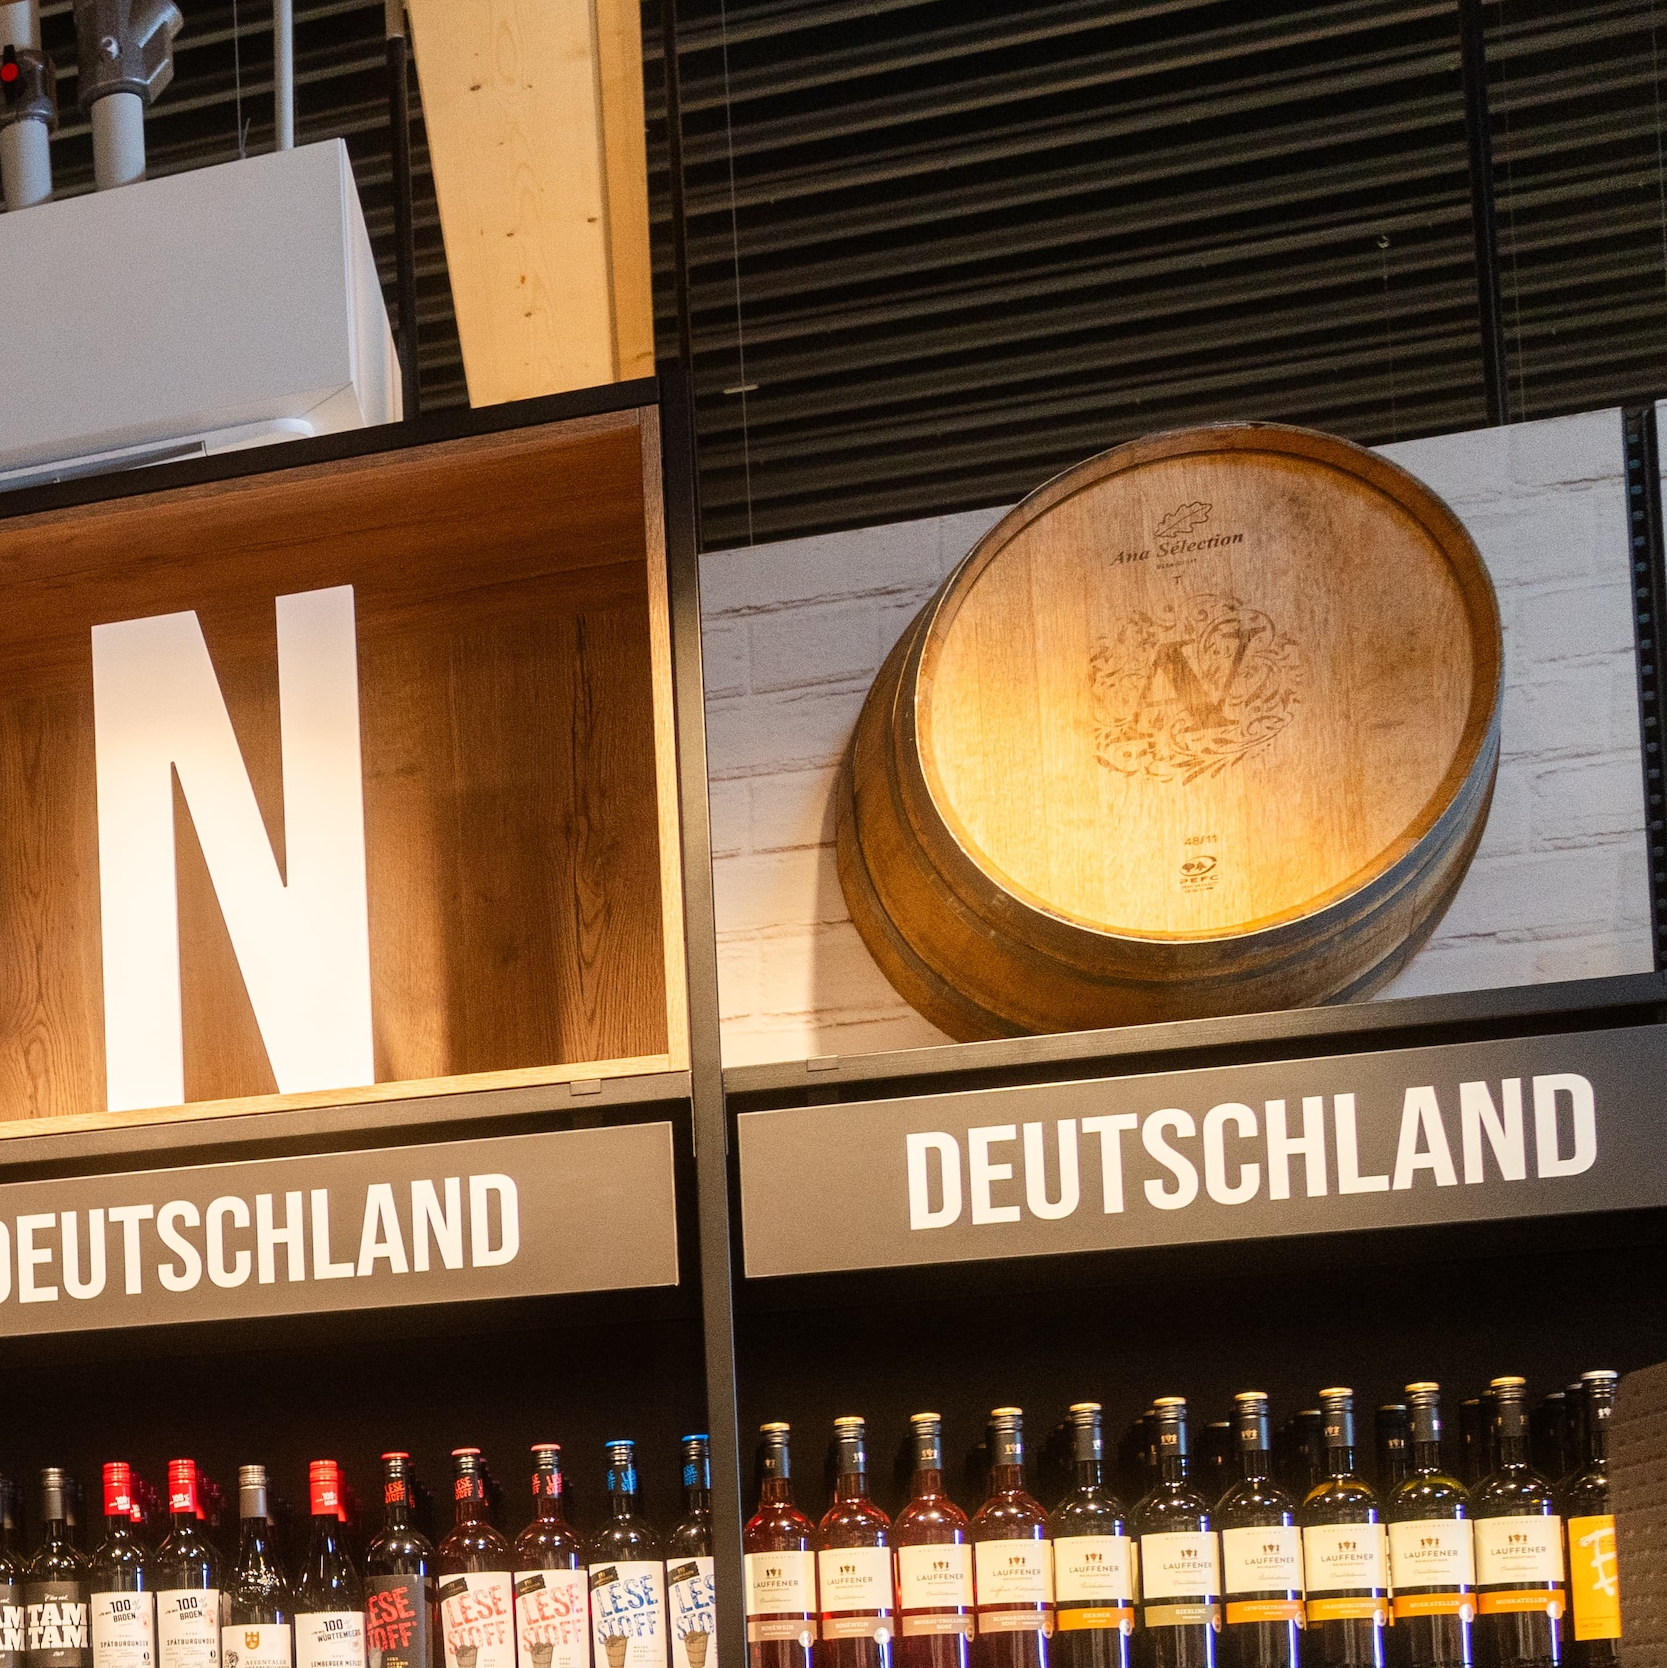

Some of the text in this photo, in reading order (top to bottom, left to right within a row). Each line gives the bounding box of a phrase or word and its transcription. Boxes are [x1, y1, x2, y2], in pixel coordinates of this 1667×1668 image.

[1109, 551, 1149, 565] Ana
[1157, 533, 1243, 557] Sélection
[1179, 875, 1219, 885] PEFC
[906, 1073, 1598, 1231] DEUTSCHLAND
[1403, 1549, 1458, 1559] LAUFFENER
[916, 1572, 964, 1582] LAUFFENER
[595, 1574, 659, 1617] LESE
[1409, 1600, 1460, 1609] MOSKATELLER
[27, 1602, 87, 1625] TAM
[28, 1625, 88, 1649] TAM
